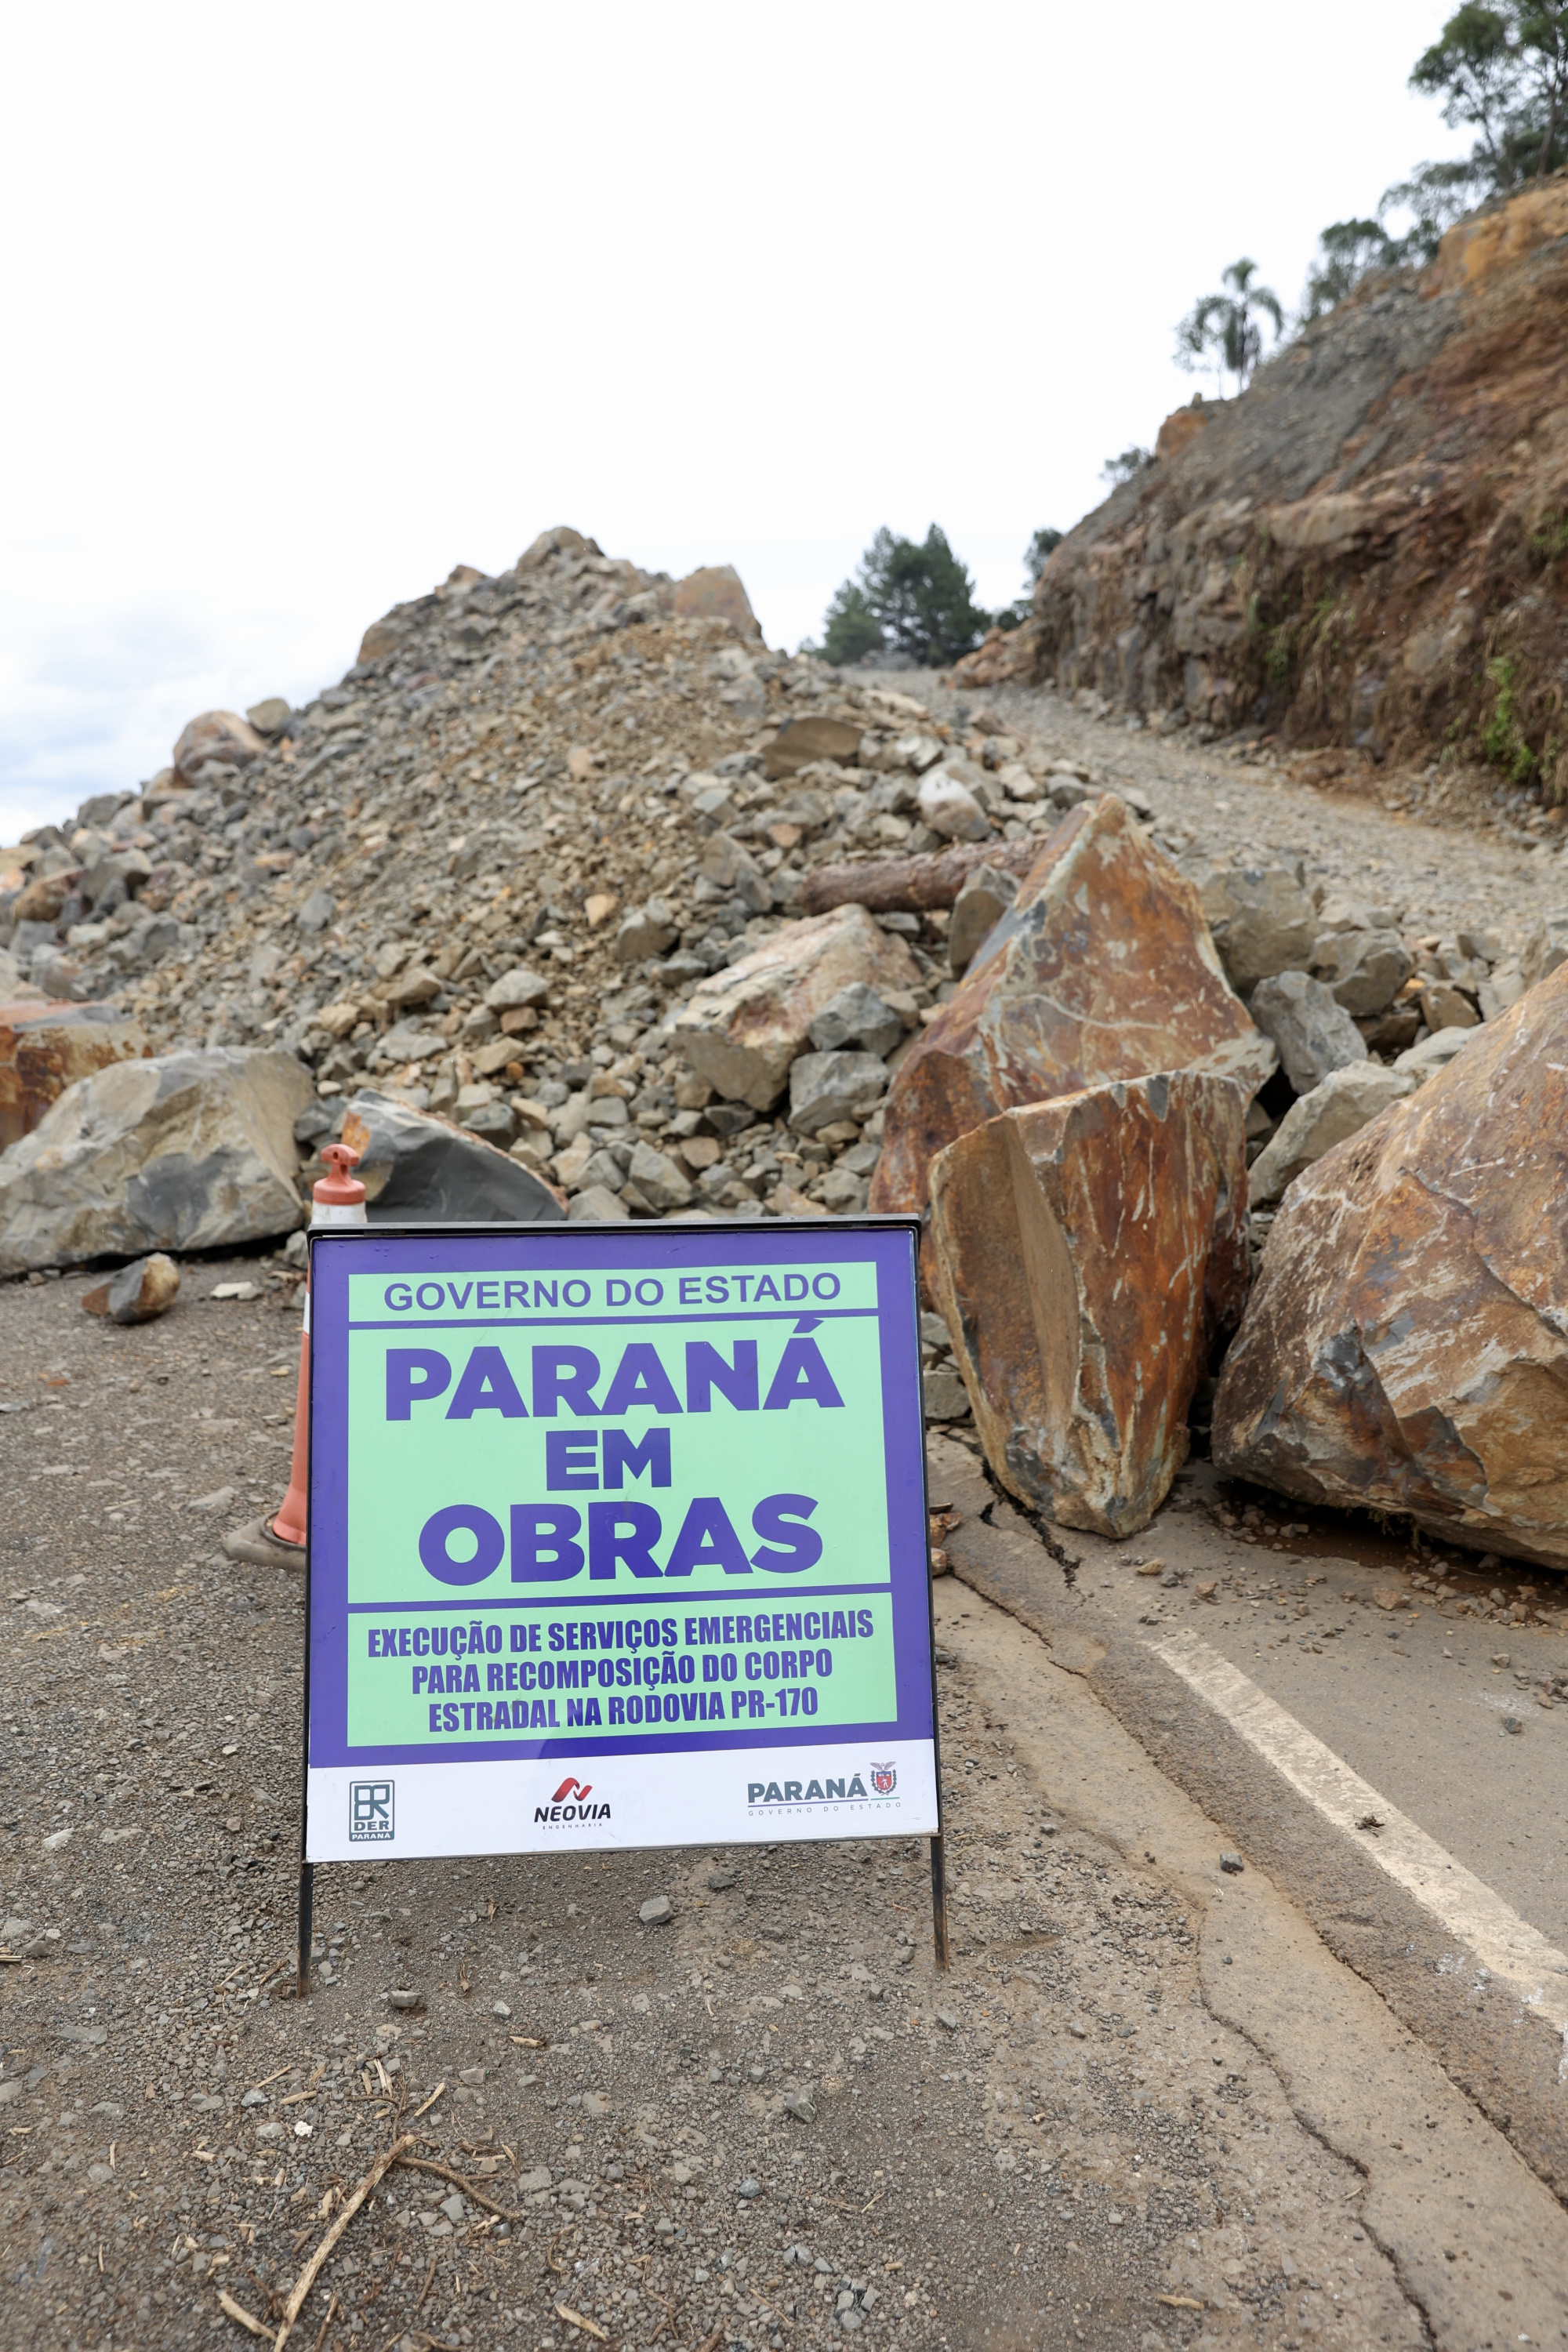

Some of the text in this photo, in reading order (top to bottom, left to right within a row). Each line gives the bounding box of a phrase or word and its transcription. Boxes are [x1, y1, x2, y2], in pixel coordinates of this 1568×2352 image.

[384, 1272, 840, 1311] GOVERNO DO ESTADO
[386, 1318, 846, 1421] PARANÁ
[546, 1428, 672, 1491] EM
[418, 1494, 823, 1586] OBRAS
[368, 1609, 873, 1661] EXECUÇÃO DE SERVIÇOS EMERGENCIAIS
[412, 1648, 833, 1694] PARA RECOMPOSIÇÃO DO CORPO
[429, 1686, 818, 1732] ESTRADAL NA RODOVIA PR-170
[747, 1773, 868, 1803] PARANÁ
[748, 1806, 813, 1817] GOVERNO
[850, 1802, 902, 1811] ESTADO
[354, 1820, 390, 1831] DER
[534, 1803, 611, 1823] NEOVIA
